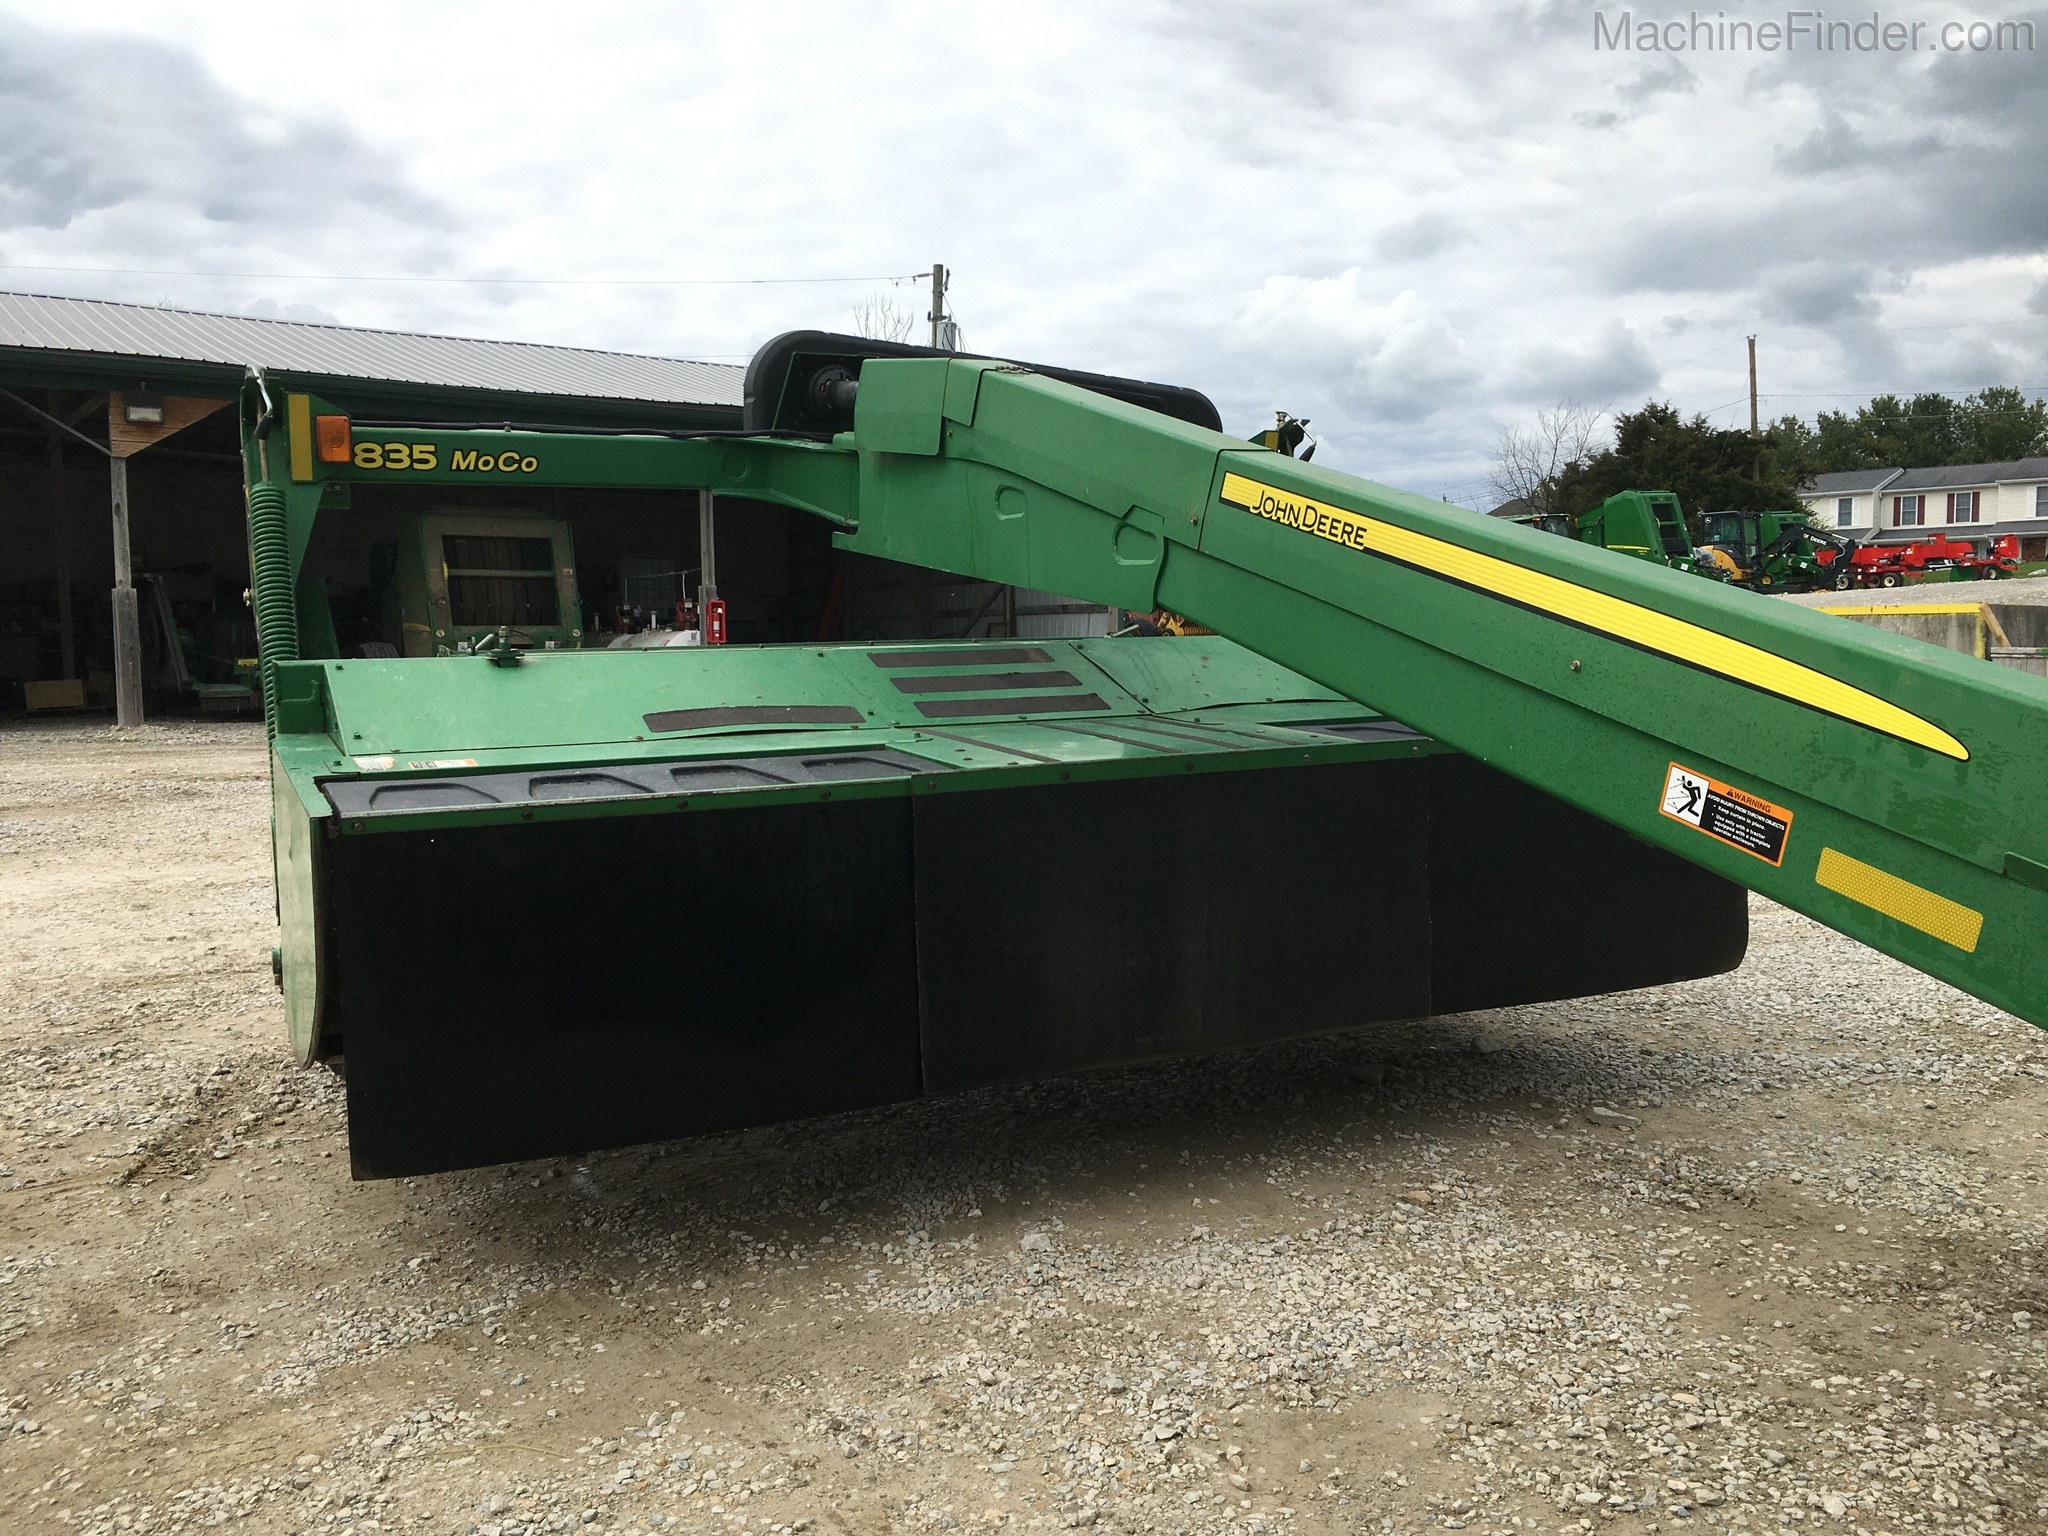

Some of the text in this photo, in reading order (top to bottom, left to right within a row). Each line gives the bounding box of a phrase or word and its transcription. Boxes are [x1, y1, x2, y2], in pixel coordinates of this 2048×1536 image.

[352, 441, 540, 473] 835 MoCo
[1252, 490, 1368, 547] JOHN DEERE
[1707, 794, 1785, 831] AVOID INJURY FROM THROWN OBJECTS
[1718, 805, 1730, 815] Keep
[1730, 811, 1746, 822] curtain
[1734, 792, 1771, 813] WARNING
[1713, 826, 1732, 837] operator
[1714, 820, 1735, 833] equipped
[1735, 829, 1746, 837] with
[1749, 836, 1771, 849] complete
[1725, 818, 1735, 827] only
[1735, 823, 1746, 831] with
[1750, 829, 1766, 840] tractor
